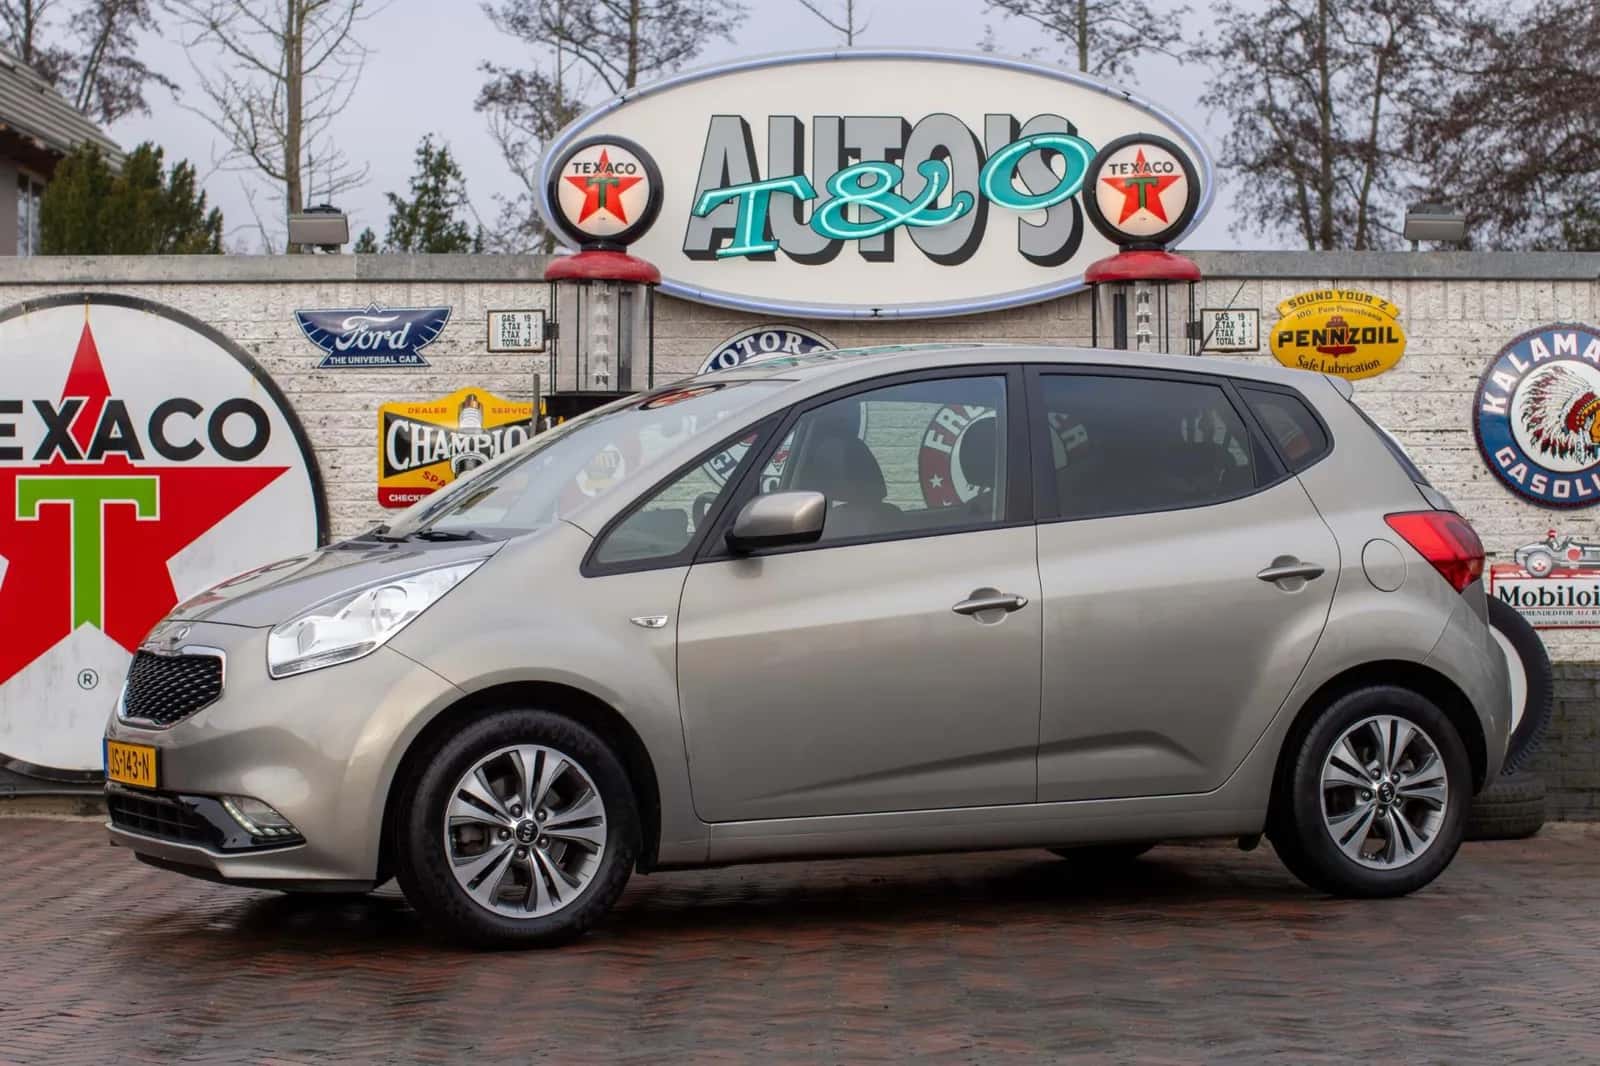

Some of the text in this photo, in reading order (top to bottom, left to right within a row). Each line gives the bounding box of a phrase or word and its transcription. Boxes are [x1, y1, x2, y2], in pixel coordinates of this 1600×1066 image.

[573, 162, 637, 175] TEXACO
[1109, 161, 1174, 175] TEXACO
[1287, 290, 1389, 310] SOUND YOUR Z
[501, 314, 516, 322] GAS
[335, 315, 412, 351] Ford
[1278, 326, 1399, 349] PENNZOIL
[502, 338, 521, 347] TOTAL
[1216, 338, 1235, 346] TOTAL
[329, 354, 418, 365] THE UNIVERSAL CAR
[707, 332, 802, 370] OTOR
[1296, 354, 1381, 374] Safe Lubrication
[386, 416, 552, 471] CHAMPIO
